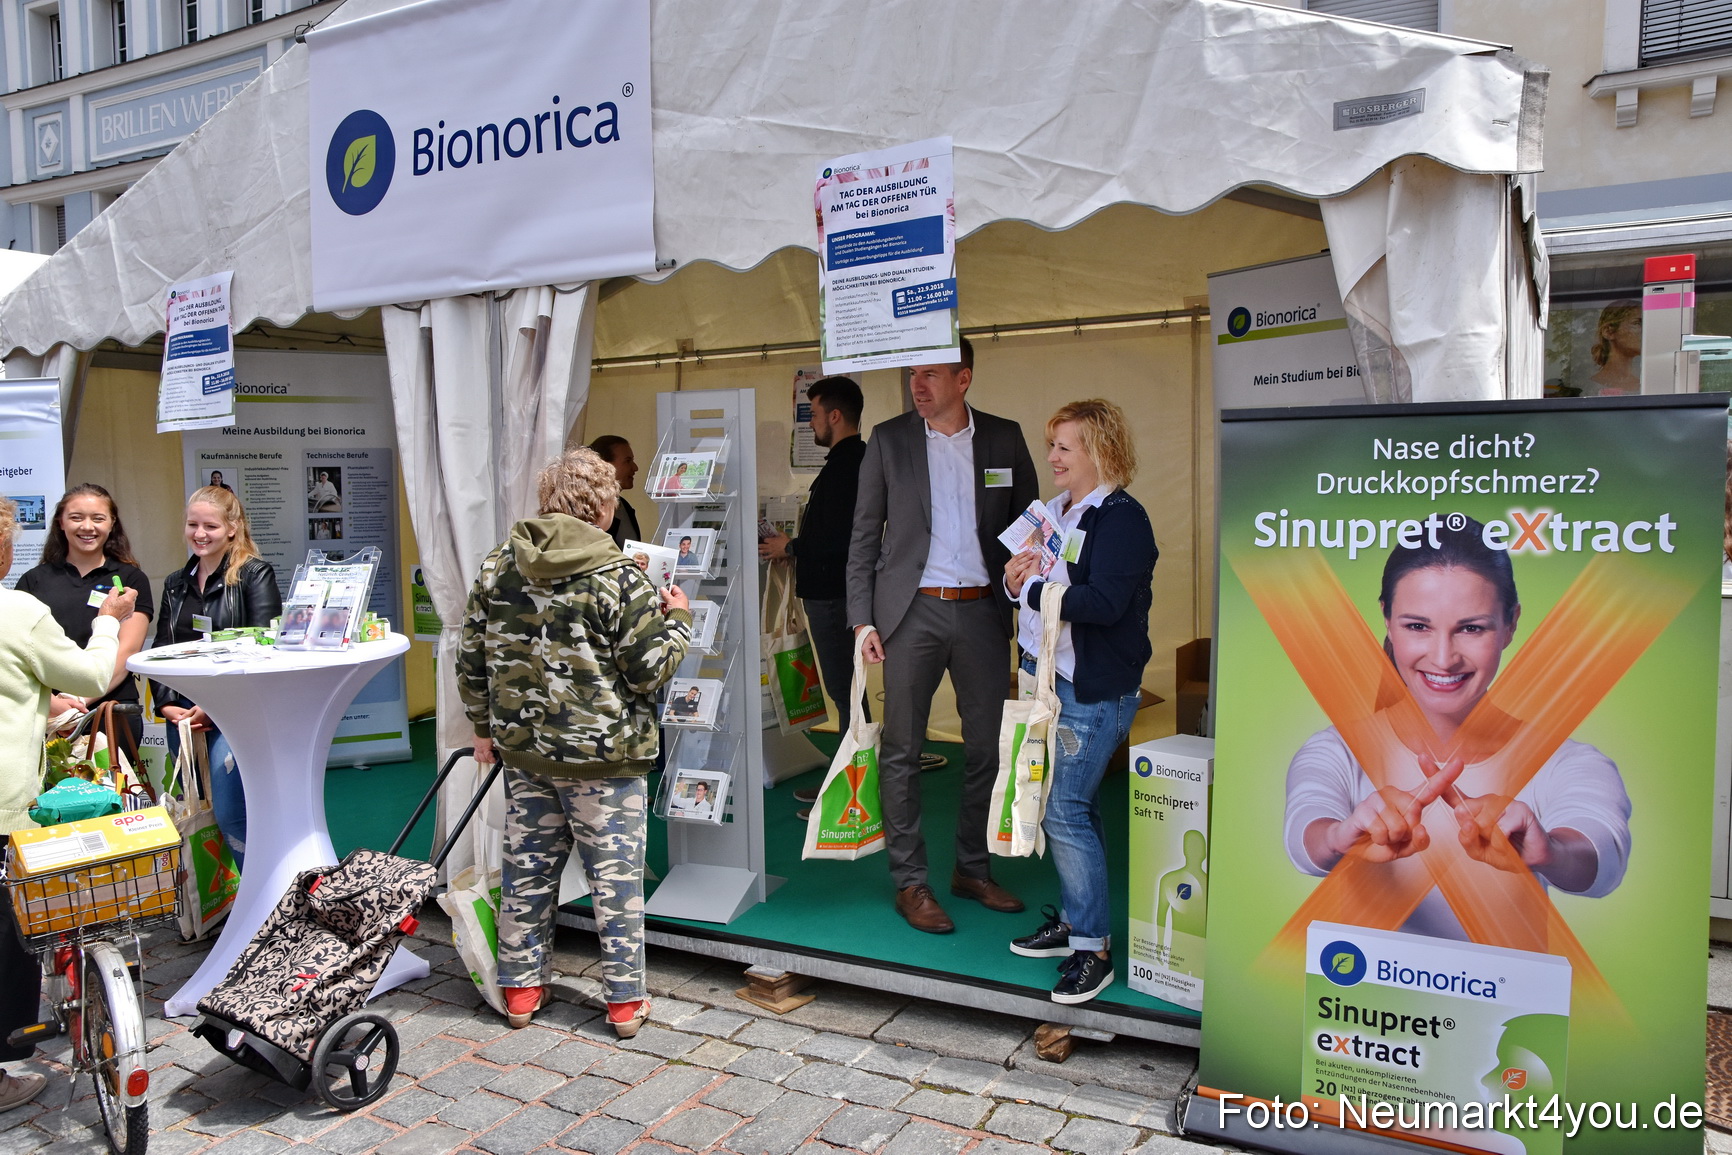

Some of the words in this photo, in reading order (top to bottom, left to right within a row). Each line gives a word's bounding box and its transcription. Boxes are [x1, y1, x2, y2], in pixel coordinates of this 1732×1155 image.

[1352, 97, 1417, 115] LOSBERGER
[102, 99, 176, 144] BRILLEN
[840, 189, 854, 199] TAG
[856, 186, 873, 196] DER
[875, 176, 928, 193] AUSBILDUNG
[831, 204, 844, 212] AM
[846, 200, 860, 210] TAG
[862, 196, 878, 206] DER
[880, 190, 918, 204] OFFENEN
[920, 186, 937, 196] TÜR
[856, 209, 869, 219] bei
[871, 205, 909, 217] Bionorica
[917, 283, 944, 293] 22.9.2018
[1254, 374, 1278, 386] Mein
[1281, 369, 1324, 384] Studium
[1327, 366, 1343, 379] bei
[222, 427, 251, 435] Meine
[254, 427, 305, 437] Ausbildung
[308, 427, 321, 435] bei
[324, 426, 365, 435] Bionorica
[1373, 438, 1440, 461] Nase
[1449, 433, 1535, 460] dicht?
[1317, 468, 1600, 500] Druckkopfschmerz?
[114, 814, 144, 827] apo
[1134, 806, 1151, 818] Saft
[1154, 811, 1164, 821] TE
[821, 829, 855, 841] Sinupret
[1134, 943, 1161, 955] Beschwerden
[1141, 938, 1163, 950] Besserung
[1134, 950, 1155, 960] Bronchitis
[1133, 965, 1152, 980] 100
[1161, 973, 1170, 981] [N2]
[1171, 976, 1196, 988] Flüssigkeit
[1165, 981, 1190, 993] Einnehmen
[1317, 1028, 1421, 1069] extract
[1316, 1059, 1326, 1067] Bei
[1328, 1061, 1355, 1073] akuten,
[1356, 1067, 1417, 1084] unkomplizierten
[1315, 1079, 1337, 1096] 20
[1341, 1084, 1356, 1094] [N1]
[1357, 1088, 1401, 1102] überzogene
[1316, 1068, 1367, 1084] Entzündungen
[1368, 1078, 1380, 1086] der
[1382, 1081, 1456, 1101] Nasennebenhöhlen
